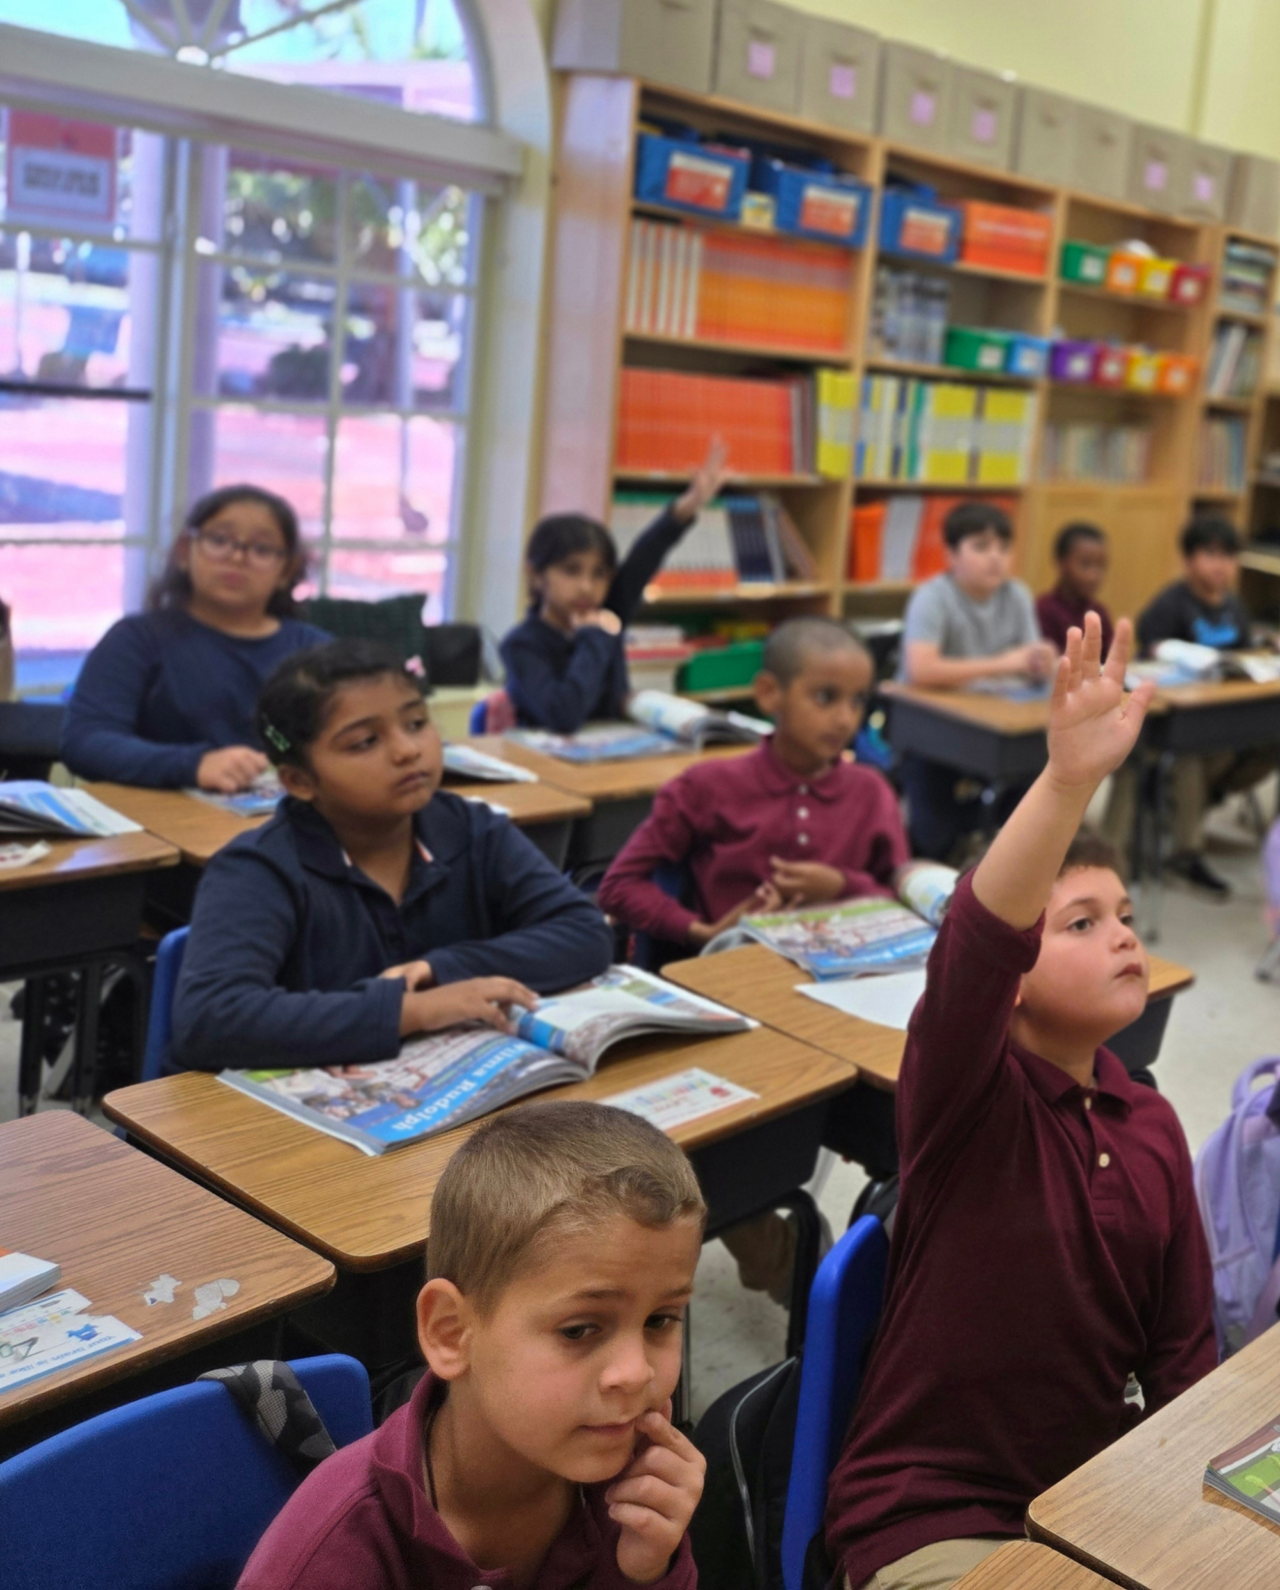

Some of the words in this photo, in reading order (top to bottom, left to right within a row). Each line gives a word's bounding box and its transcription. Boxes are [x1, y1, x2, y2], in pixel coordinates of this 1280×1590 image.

[88, 1335, 116, 1348] Your
[51, 1346, 87, 1361] brain
[9, 1364, 34, 1374] like
